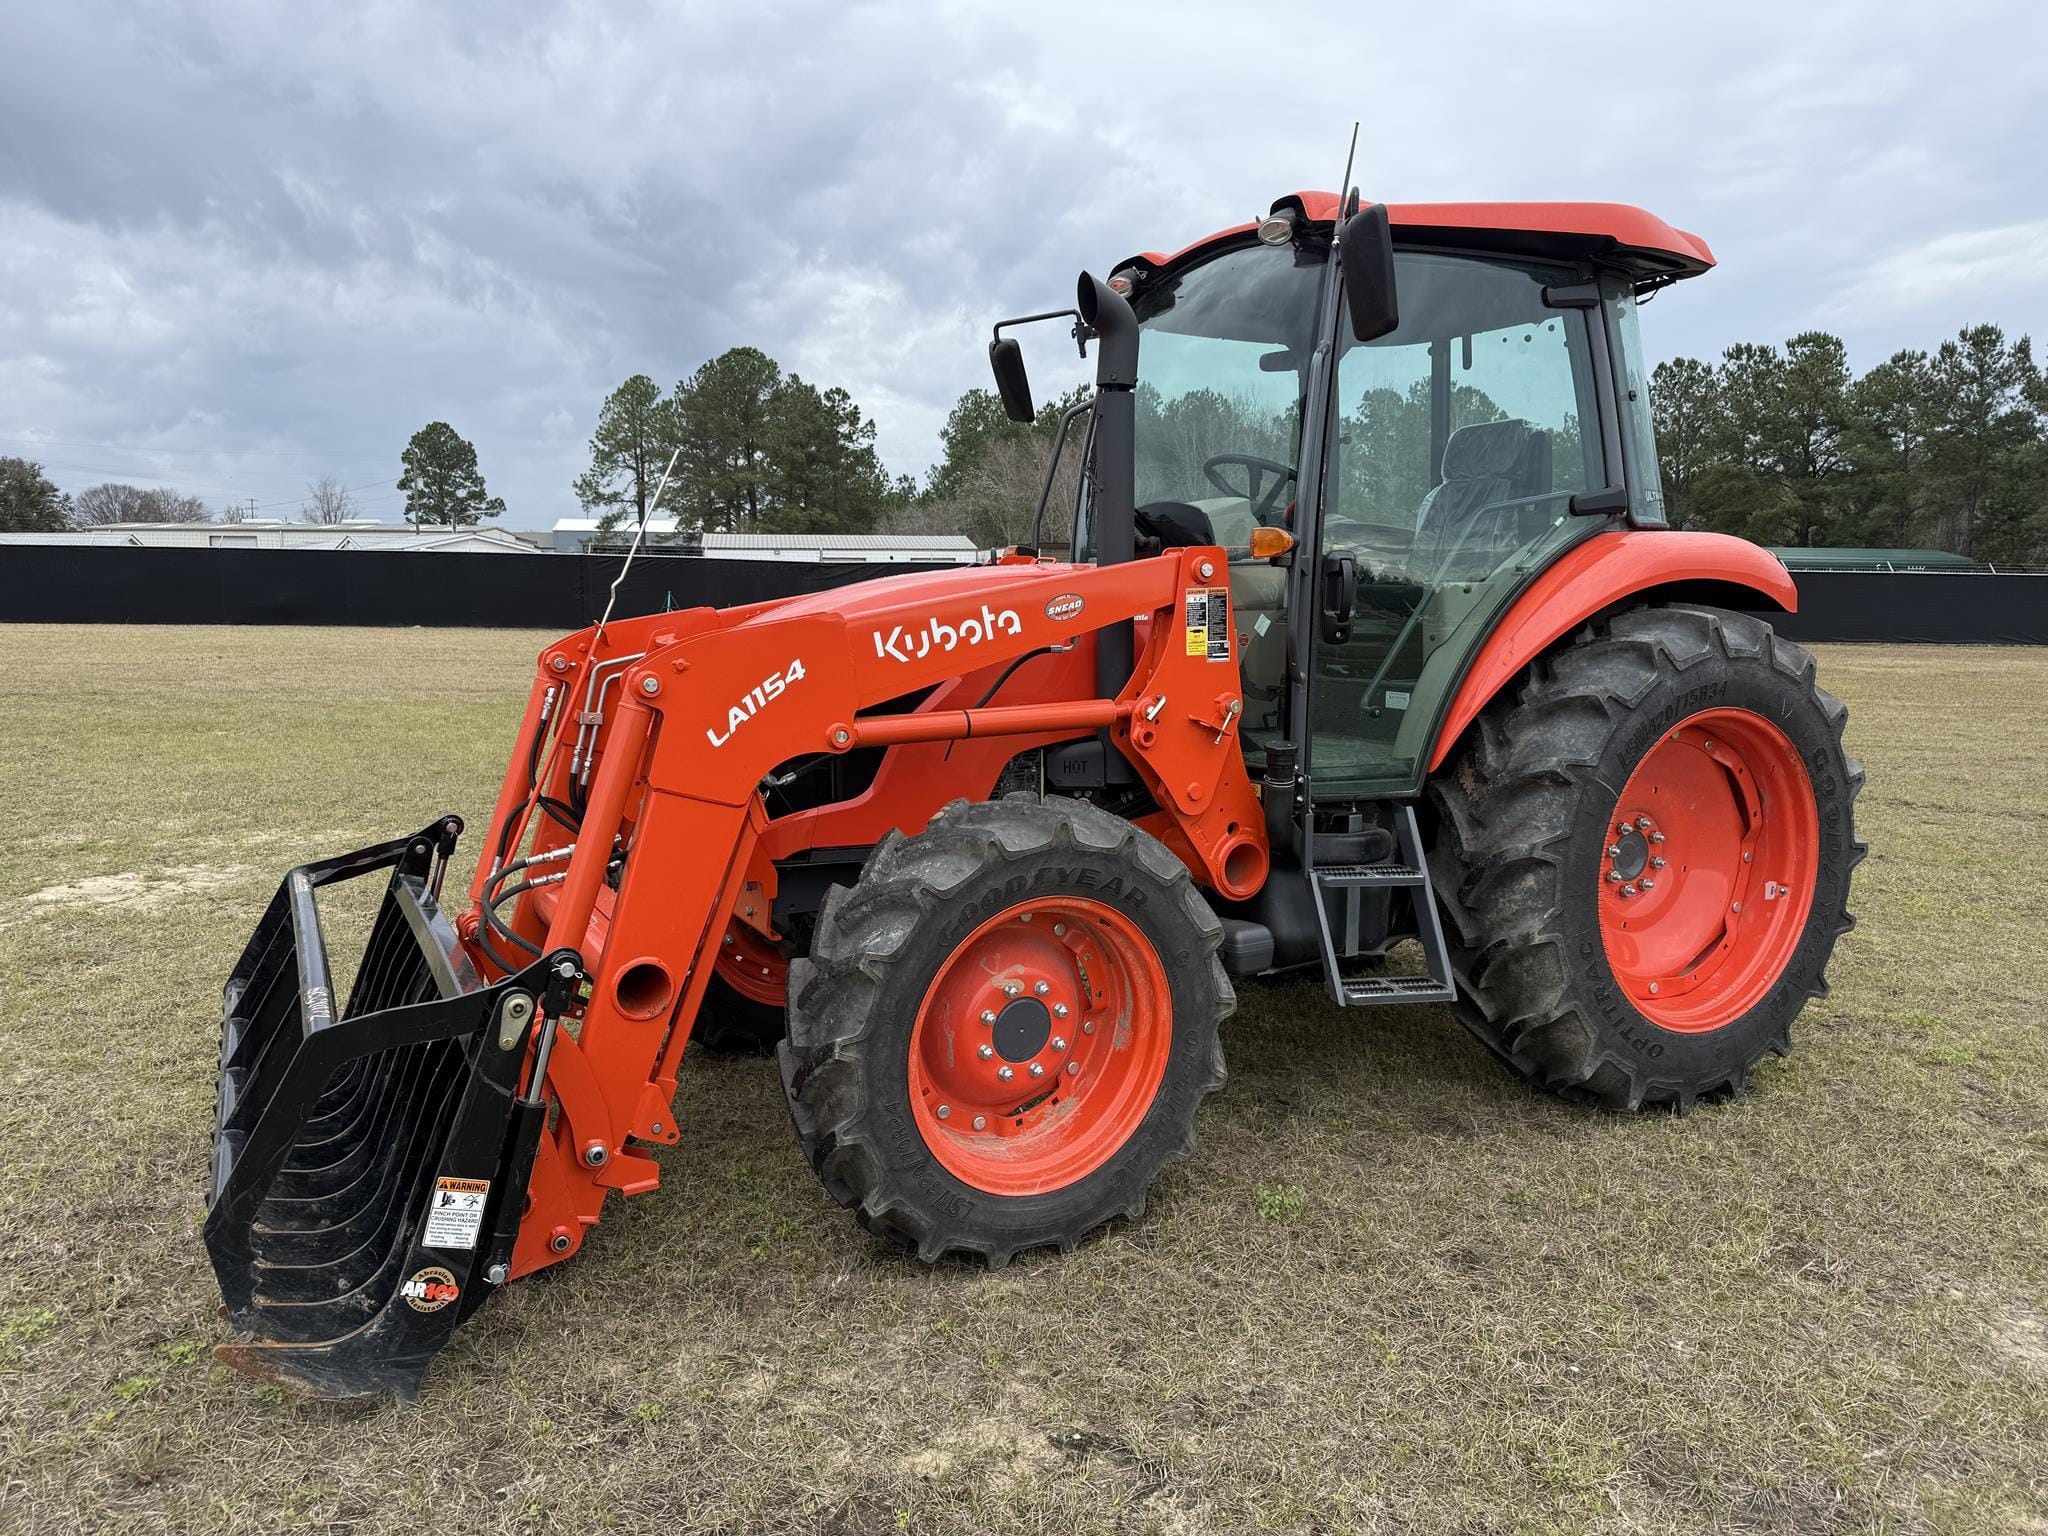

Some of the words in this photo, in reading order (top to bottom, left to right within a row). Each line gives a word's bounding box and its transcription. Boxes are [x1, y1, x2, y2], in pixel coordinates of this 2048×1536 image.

[1048, 600, 1083, 616] SNEAD
[873, 604, 1022, 663] Kubota
[706, 658, 806, 747] LA1154
[1063, 760, 1089, 774] HOT
[936, 866, 1149, 947] GOODYEAR
[1580, 941, 1665, 1060] OPTITRAC
[449, 1181, 486, 1192] WARNING
[418, 1270, 451, 1283] Abrasion
[409, 1298, 446, 1311] Resistant
